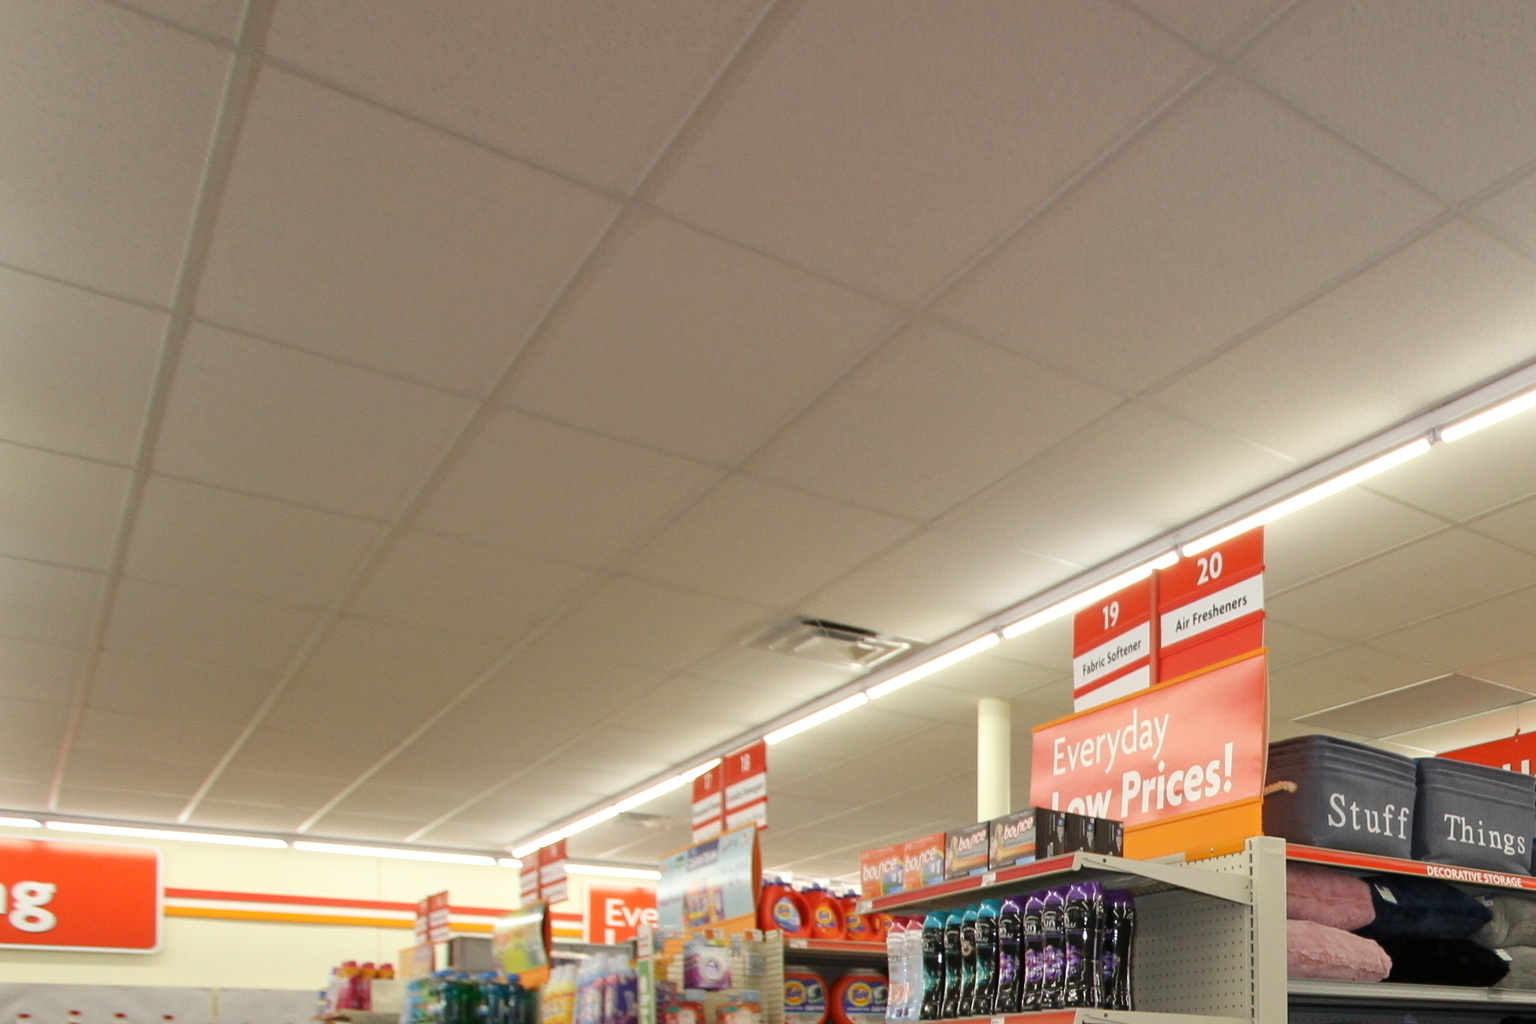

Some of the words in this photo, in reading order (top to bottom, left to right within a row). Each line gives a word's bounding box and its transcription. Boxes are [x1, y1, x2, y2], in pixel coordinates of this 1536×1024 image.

[1197, 552, 1222, 585] 20
[1102, 601, 1120, 630] 19
[1176, 616, 1190, 633] Air
[1192, 595, 1248, 626] Fresheners
[1082, 657, 1106, 677] Fabric
[1107, 639, 1142, 666] Softener
[1052, 709, 1169, 777] Everyday
[1120, 742, 1234, 818] Prices!
[1003, 816, 1033, 840] bounce
[1328, 792, 1410, 840] Stuff
[959, 829, 986, 851] bounce
[1444, 813, 1525, 856] Things
[863, 858, 897, 881] bounce
[905, 847, 935, 871] bounce
[1427, 865, 1482, 883] DECORATIVE
[1484, 872, 1522, 887] STORAGE
